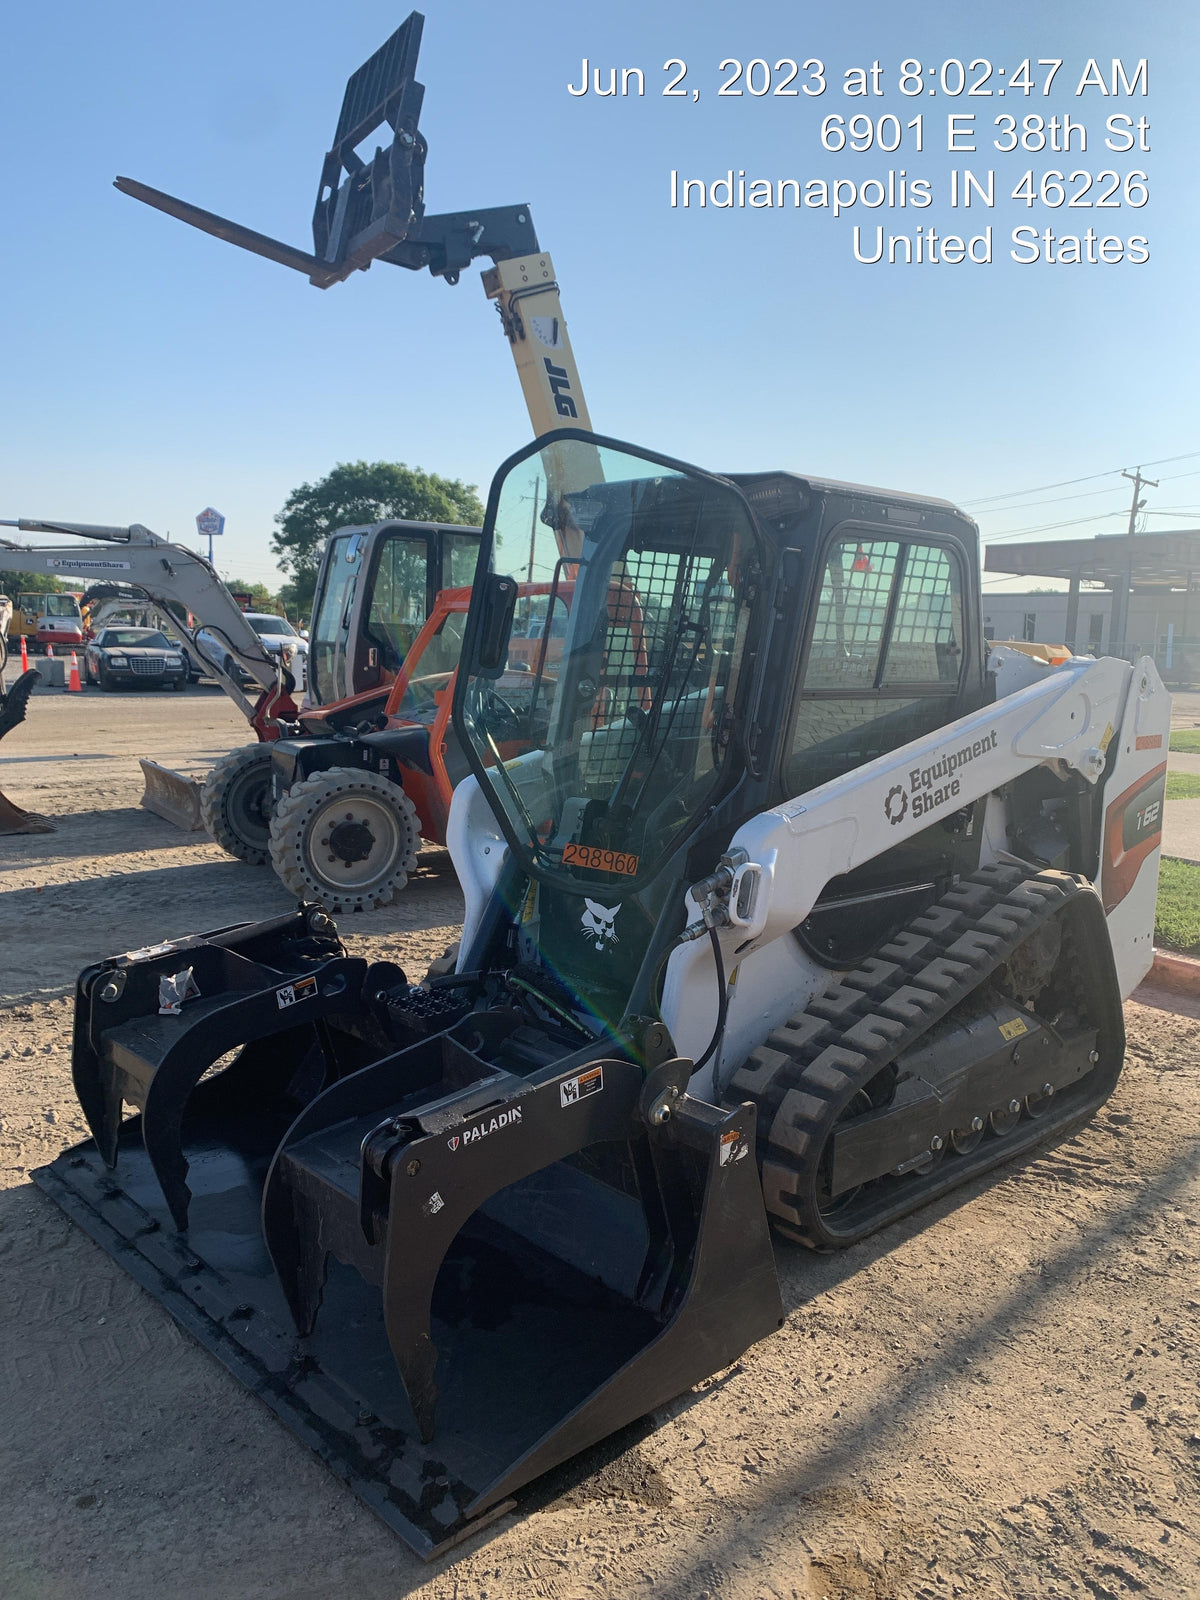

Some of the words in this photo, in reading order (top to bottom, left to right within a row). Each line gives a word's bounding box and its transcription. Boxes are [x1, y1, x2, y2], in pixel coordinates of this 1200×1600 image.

[544, 357, 578, 418] JLG
[908, 729, 998, 794] Equipment
[911, 779, 961, 819] Share
[563, 844, 637, 874] 298960
[462, 1105, 522, 1145] PALADIN
